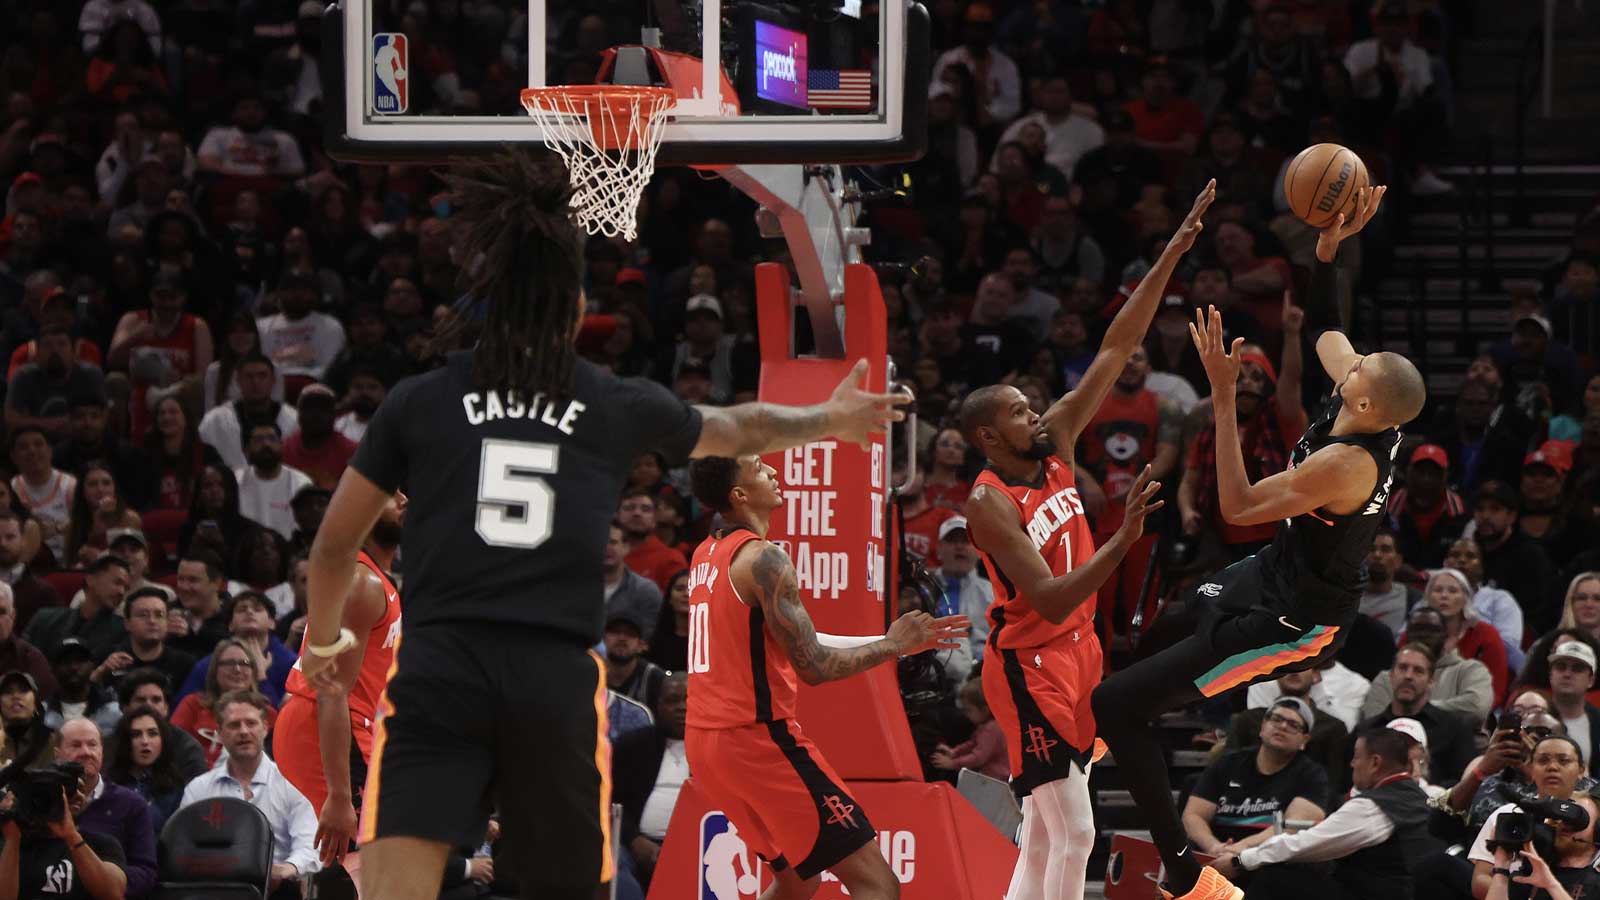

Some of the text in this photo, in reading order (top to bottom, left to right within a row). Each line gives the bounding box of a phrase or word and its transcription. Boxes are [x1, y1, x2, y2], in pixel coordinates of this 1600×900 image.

[763, 45, 796, 90] peacock
[377, 95, 395, 109] NBA
[1318, 162, 1352, 212] Wilson
[462, 389, 587, 436] CASTLE
[784, 441, 838, 487] GET
[474, 437, 560, 550] 5
[782, 490, 838, 537] THE
[796, 541, 849, 600] App
